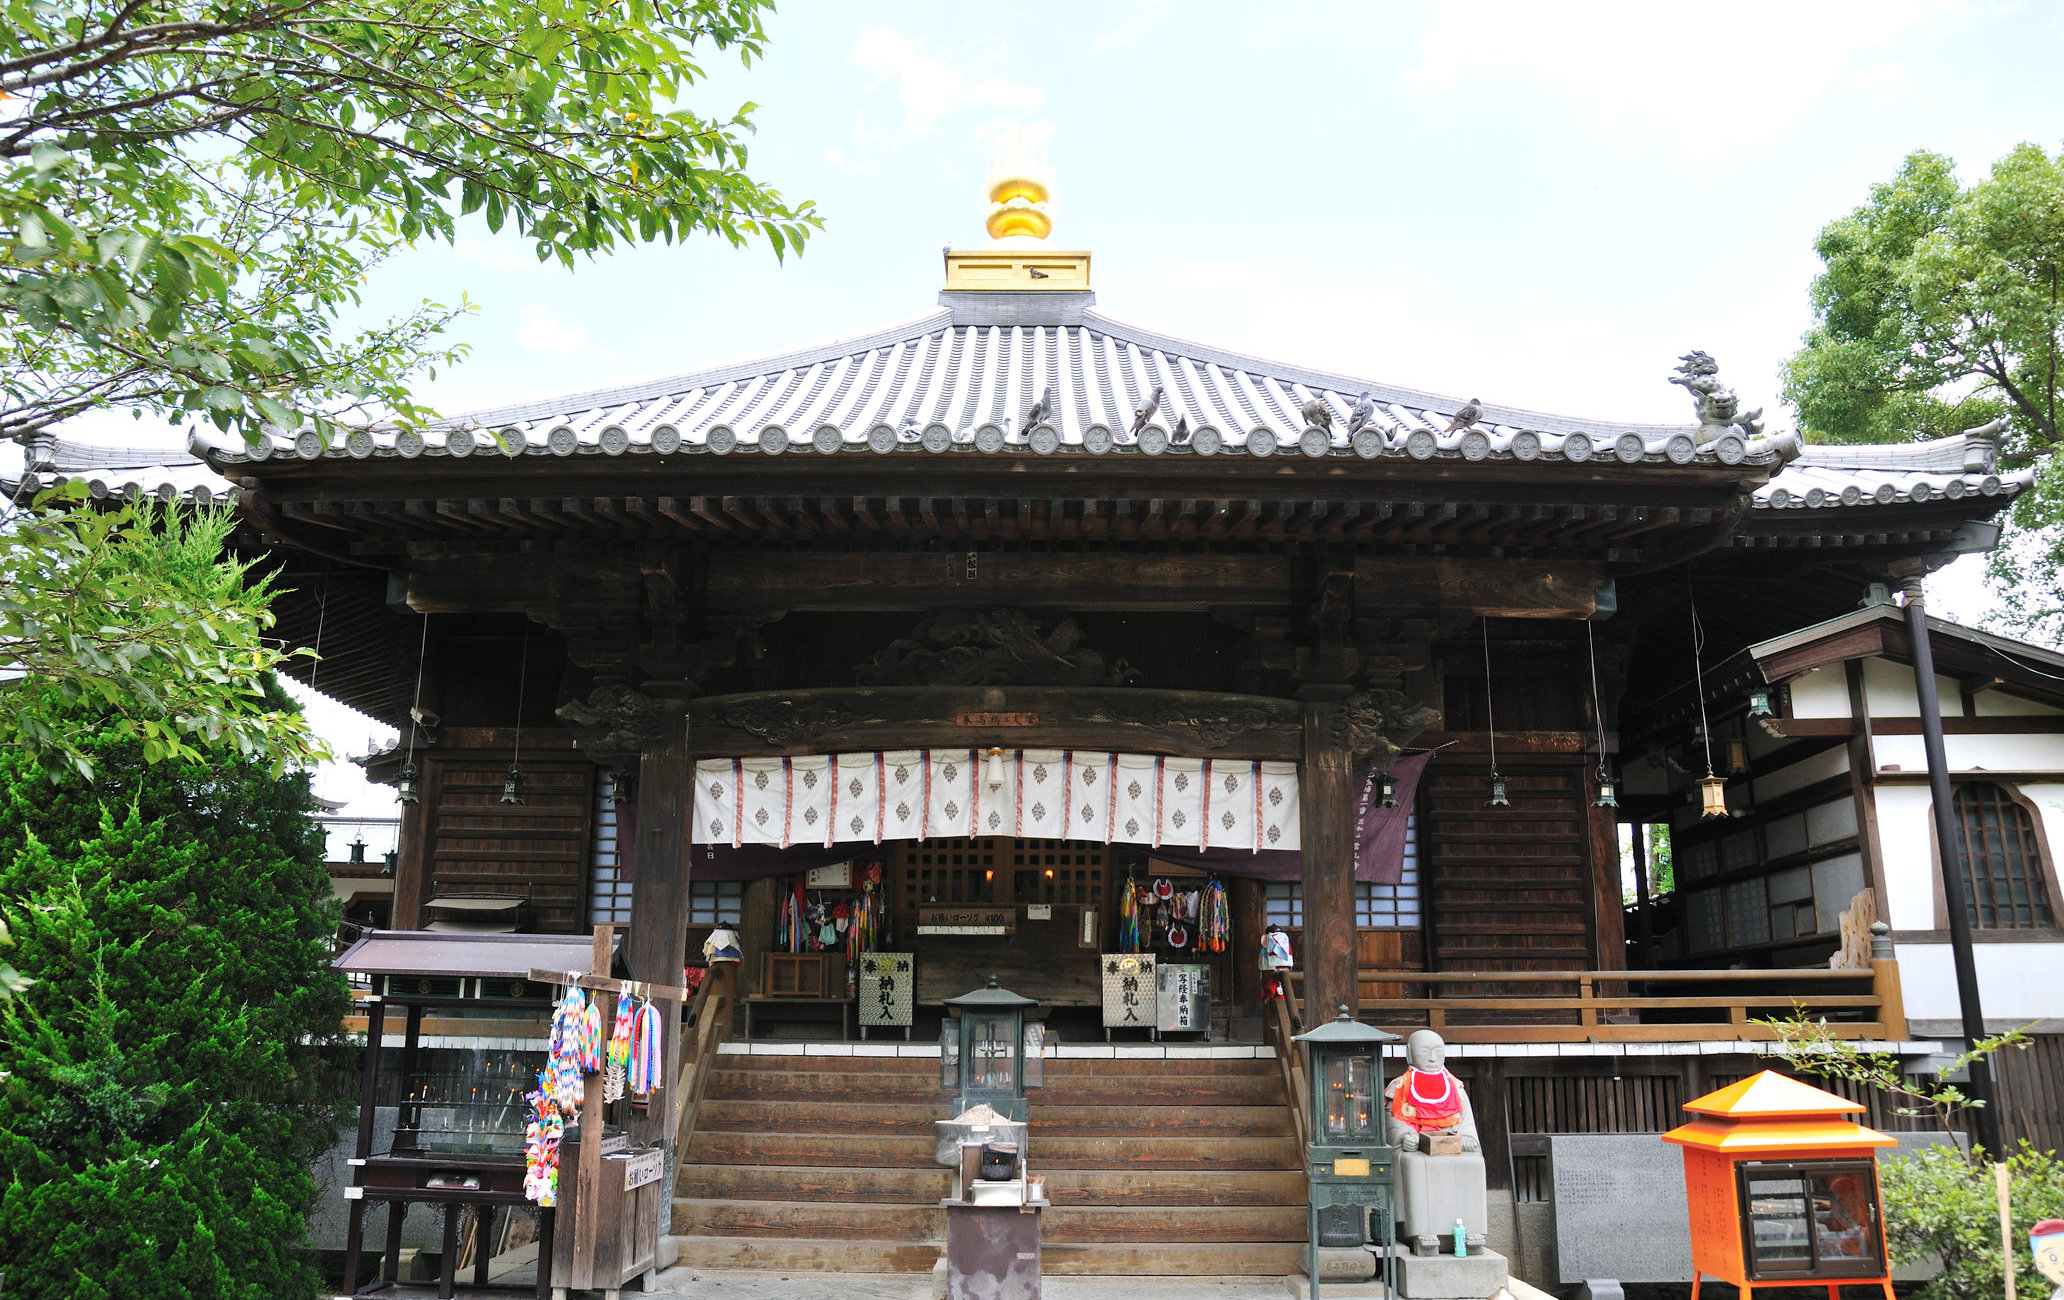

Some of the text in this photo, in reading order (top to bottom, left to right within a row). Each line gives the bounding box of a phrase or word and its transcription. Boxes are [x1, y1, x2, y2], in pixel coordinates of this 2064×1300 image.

[985, 913, 1004, 924] ¥100
[878, 975, 895, 1020] 納札入
[1122, 976, 1139, 1022] 納札入
[1178, 973, 1189, 1026] 写経奉納箱
